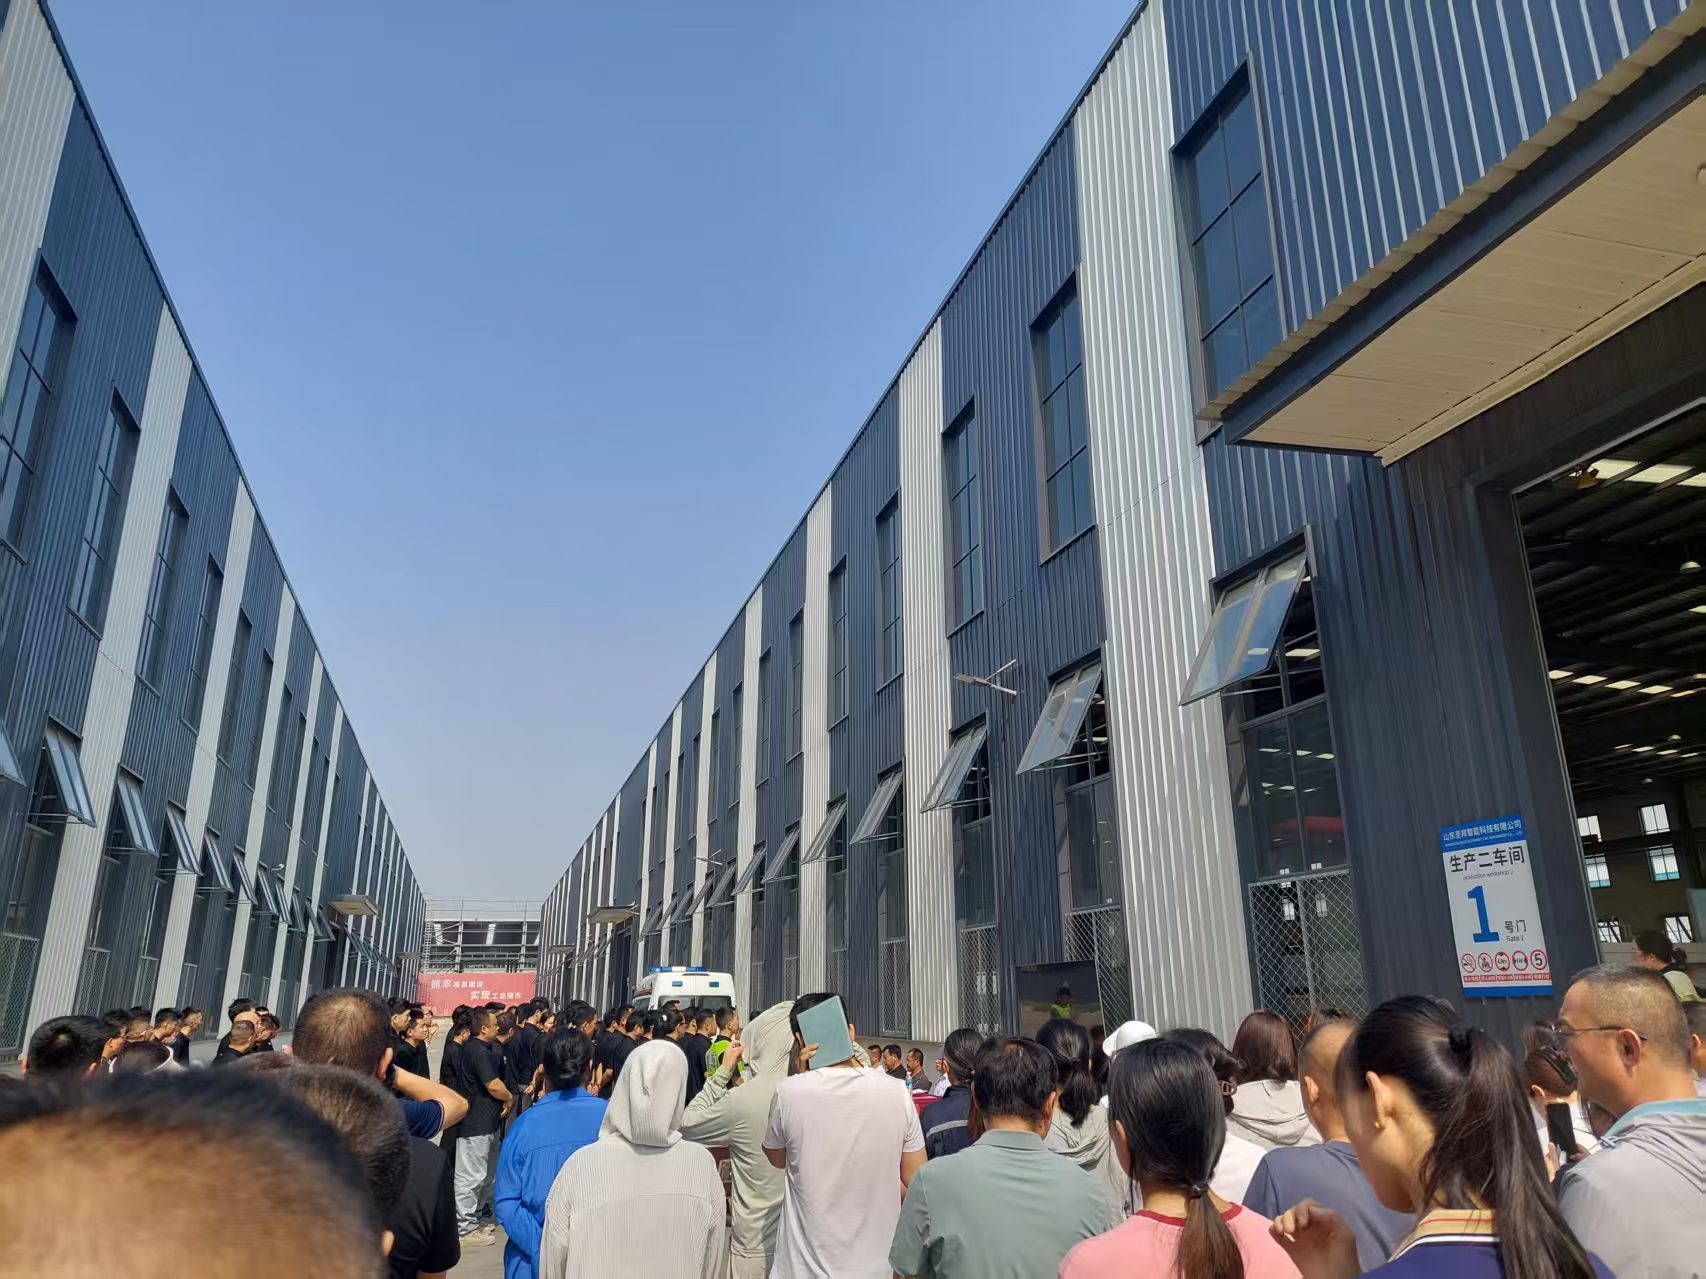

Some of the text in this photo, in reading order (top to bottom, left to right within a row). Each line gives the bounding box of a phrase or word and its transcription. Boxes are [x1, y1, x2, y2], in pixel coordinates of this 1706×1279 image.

[1449, 845, 1525, 873] 生产二车间
[1462, 872, 1486, 880] production
[1486, 869, 1509, 878] workshop
[1467, 885, 1500, 943] 1
[1504, 919, 1527, 933] 号门
[1534, 953, 1543, 967] 5
